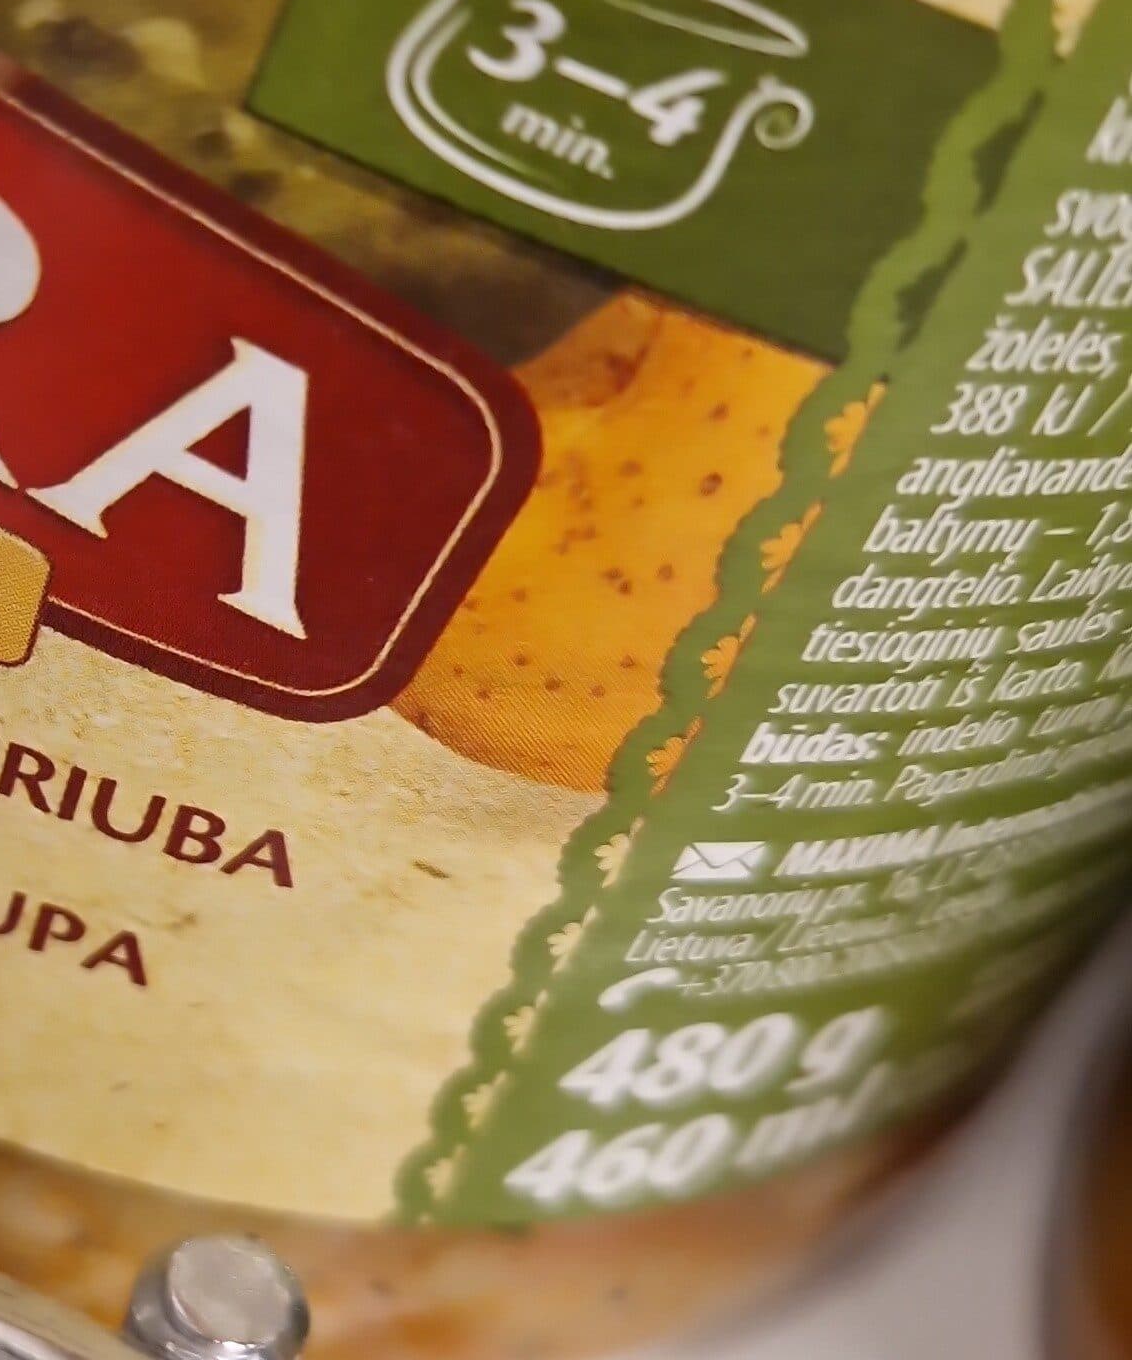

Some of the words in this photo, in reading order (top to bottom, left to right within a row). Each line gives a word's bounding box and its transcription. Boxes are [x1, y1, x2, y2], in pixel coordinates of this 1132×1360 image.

[500, 102, 614, 180] min.
[930, 382, 1028, 436] 388
[832, 562, 1024, 622] dangtelio.
[766, 664, 946, 716] suvartoti
[738, 718, 892, 768] būdas:
[556, 1010, 796, 1112] 480
[784, 1004, 890, 1098] g
[502, 1110, 734, 1210] 460
